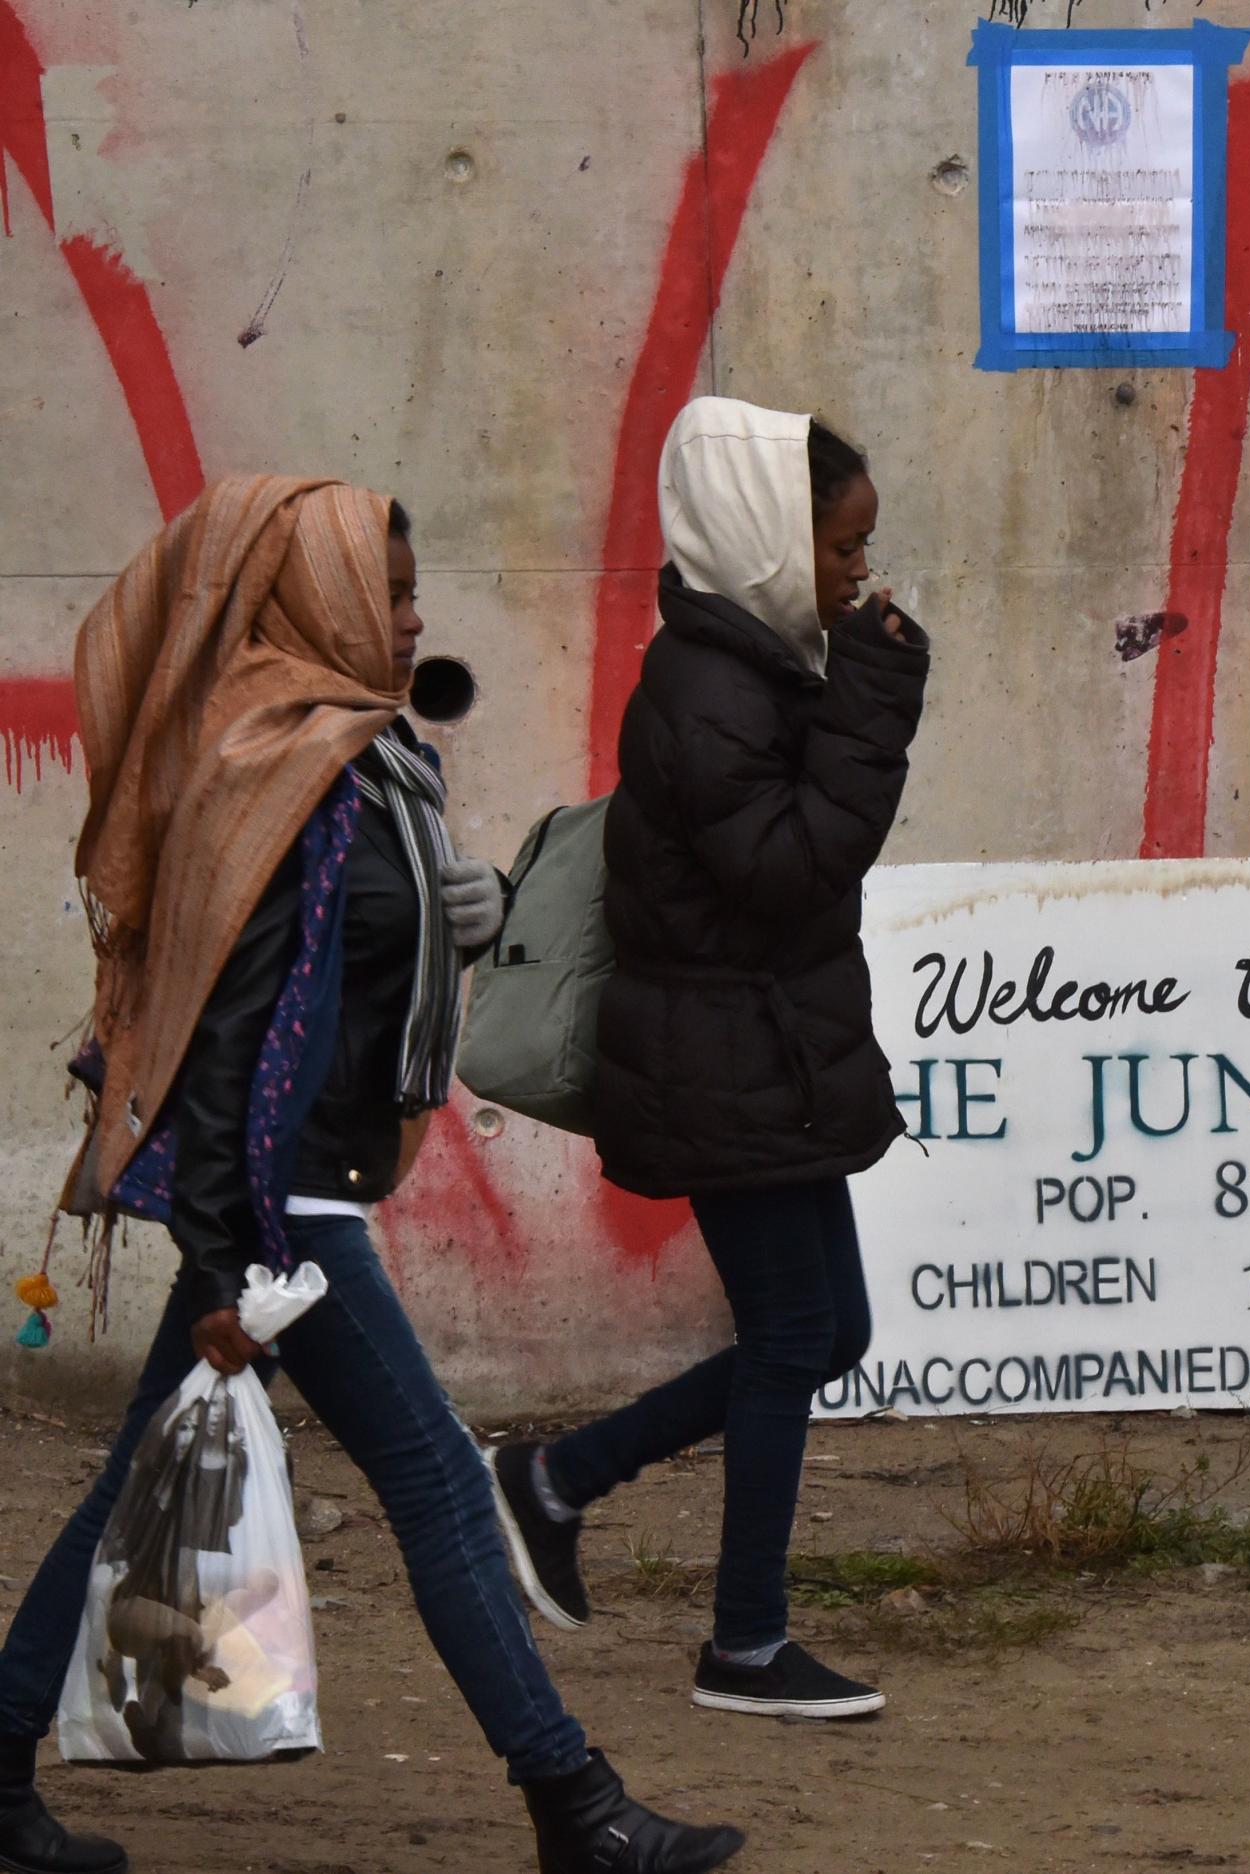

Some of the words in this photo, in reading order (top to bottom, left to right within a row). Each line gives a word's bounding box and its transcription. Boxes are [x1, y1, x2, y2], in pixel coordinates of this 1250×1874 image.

[912, 945, 1191, 1039] Welcome
[894, 1057, 1008, 1140] HE
[1035, 1175, 1149, 1225] POP.
[911, 1256, 1156, 1311] CHILDREN
